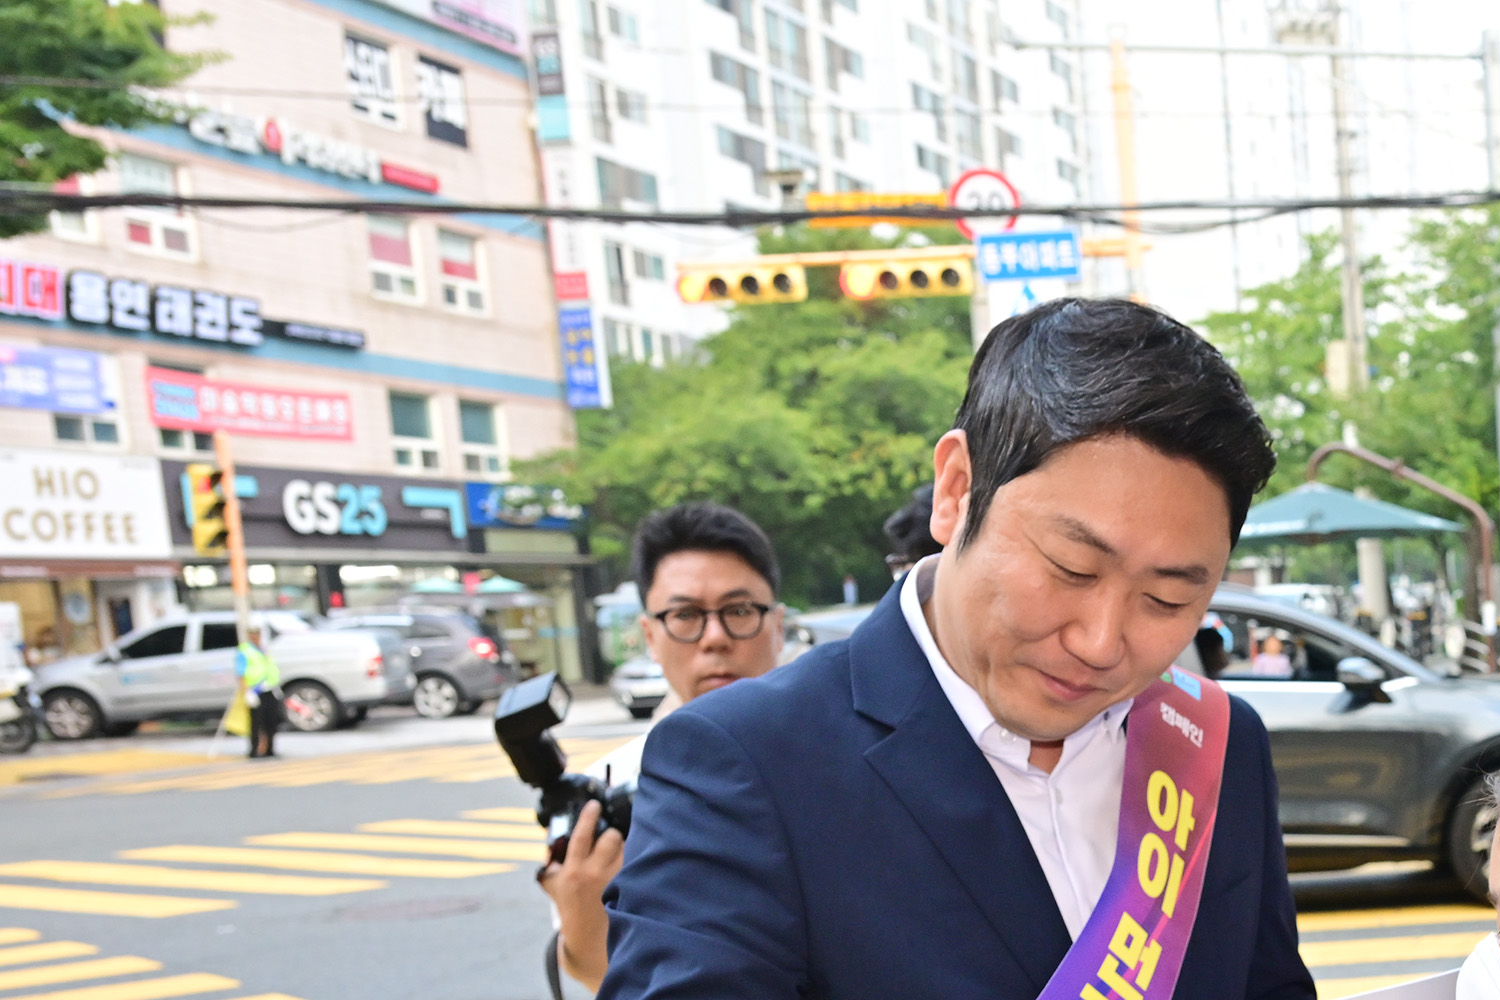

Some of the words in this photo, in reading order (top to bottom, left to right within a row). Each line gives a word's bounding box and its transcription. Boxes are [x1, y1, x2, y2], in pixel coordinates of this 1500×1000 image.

[33, 467, 100, 500] HIO
[282, 478, 388, 537] GS25
[3, 508, 138, 544] COFFEE
[1160, 701, 1204, 749] 캠페인
[1137, 770, 1196, 919] 아이
